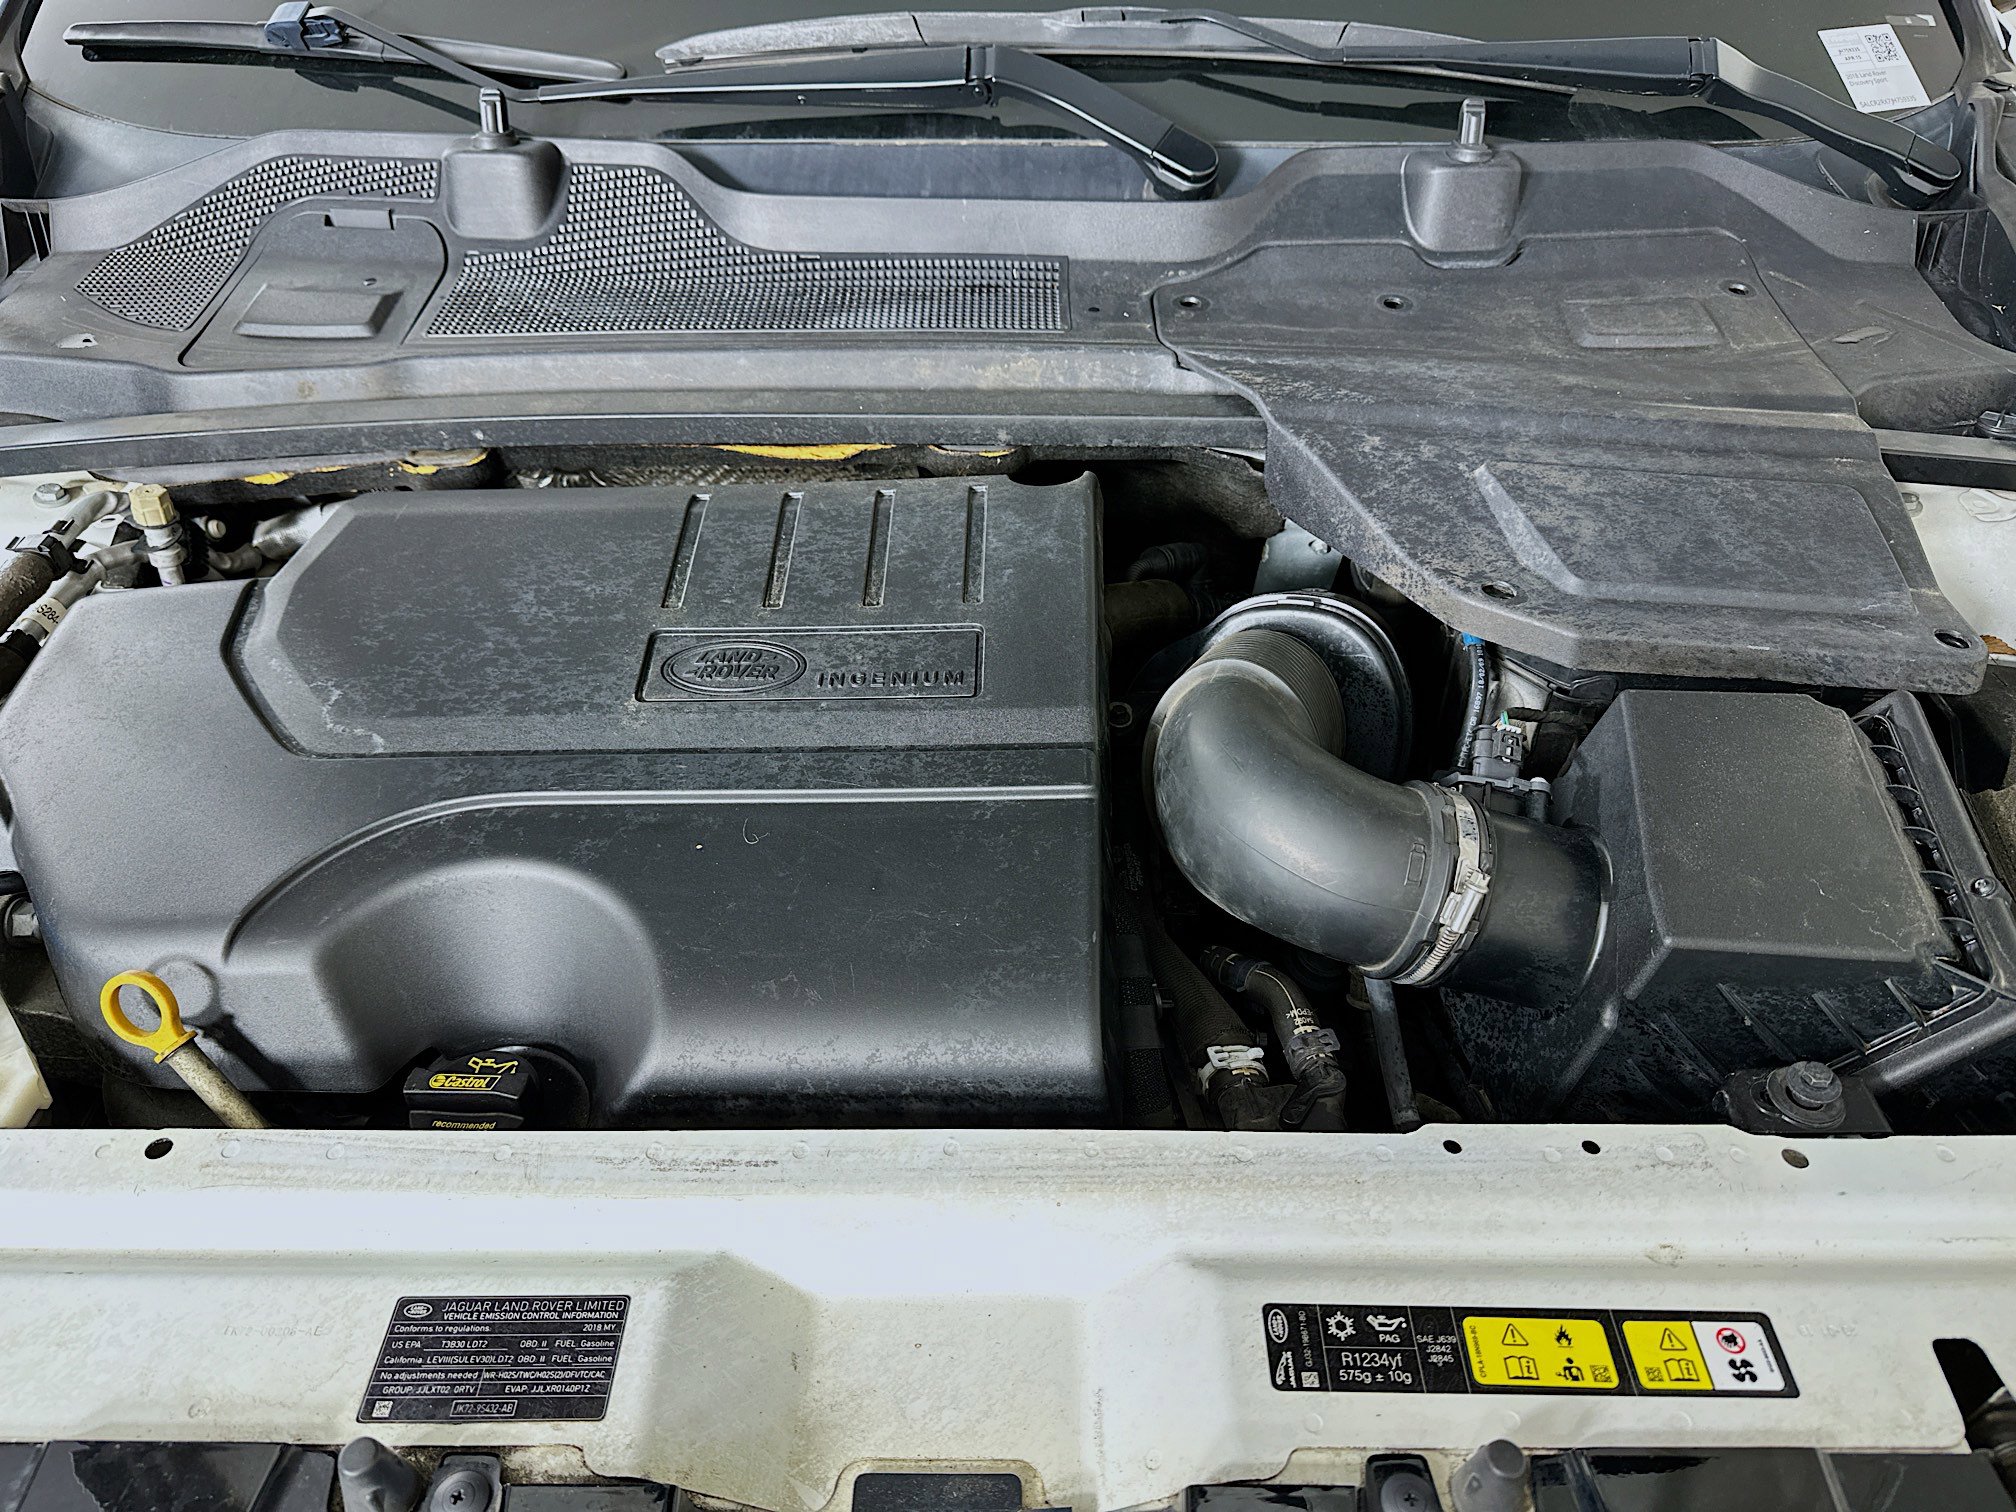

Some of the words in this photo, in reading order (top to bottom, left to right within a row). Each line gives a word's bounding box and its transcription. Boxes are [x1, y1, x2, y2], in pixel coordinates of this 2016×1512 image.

[694, 650, 763, 665] LAND
[696, 664, 780, 681] ROVER
[816, 669, 965, 688] INGENIUM
[444, 1075, 490, 1088] Castrol
[431, 1120, 497, 1130] recommended
[442, 1301, 491, 1312] JAGUAR
[494, 1301, 529, 1311] LAND
[532, 1301, 573, 1311] ROVER
[575, 1300, 625, 1311] LIMITED
[443, 1312, 478, 1320] VEHICLE
[479, 1312, 520, 1320] EMISSION
[521, 1312, 560, 1320] CONTROL
[562, 1311, 619, 1319] INFORMATION
[394, 1325, 433, 1333] Conforms
[582, 1323, 602, 1332] 2018
[603, 1323, 617, 1331] MY
[1379, 1334, 1401, 1343] PAG
[1416, 1335, 1434, 1343] SAE
[1437, 1335, 1457, 1344] J639
[391, 1341, 403, 1349] US
[404, 1341, 421, 1349] EPA
[441, 1340, 465, 1349] T3B30
[466, 1340, 488, 1348] LDT2
[580, 1339, 615, 1348] Gasoline
[1426, 1345, 1452, 1353] J2842
[577, 1354, 613, 1362] Gasoline
[1341, 1352, 1403, 1370] R1234yf
[1287, 1351, 1297, 1388] JAGUAR
[380, 1372, 393, 1380] No
[394, 1372, 445, 1381] adjustments
[447, 1371, 479, 1380] needed
[1339, 1369, 1372, 1384] 575g
[1388, 1370, 1412, 1384] 10g
